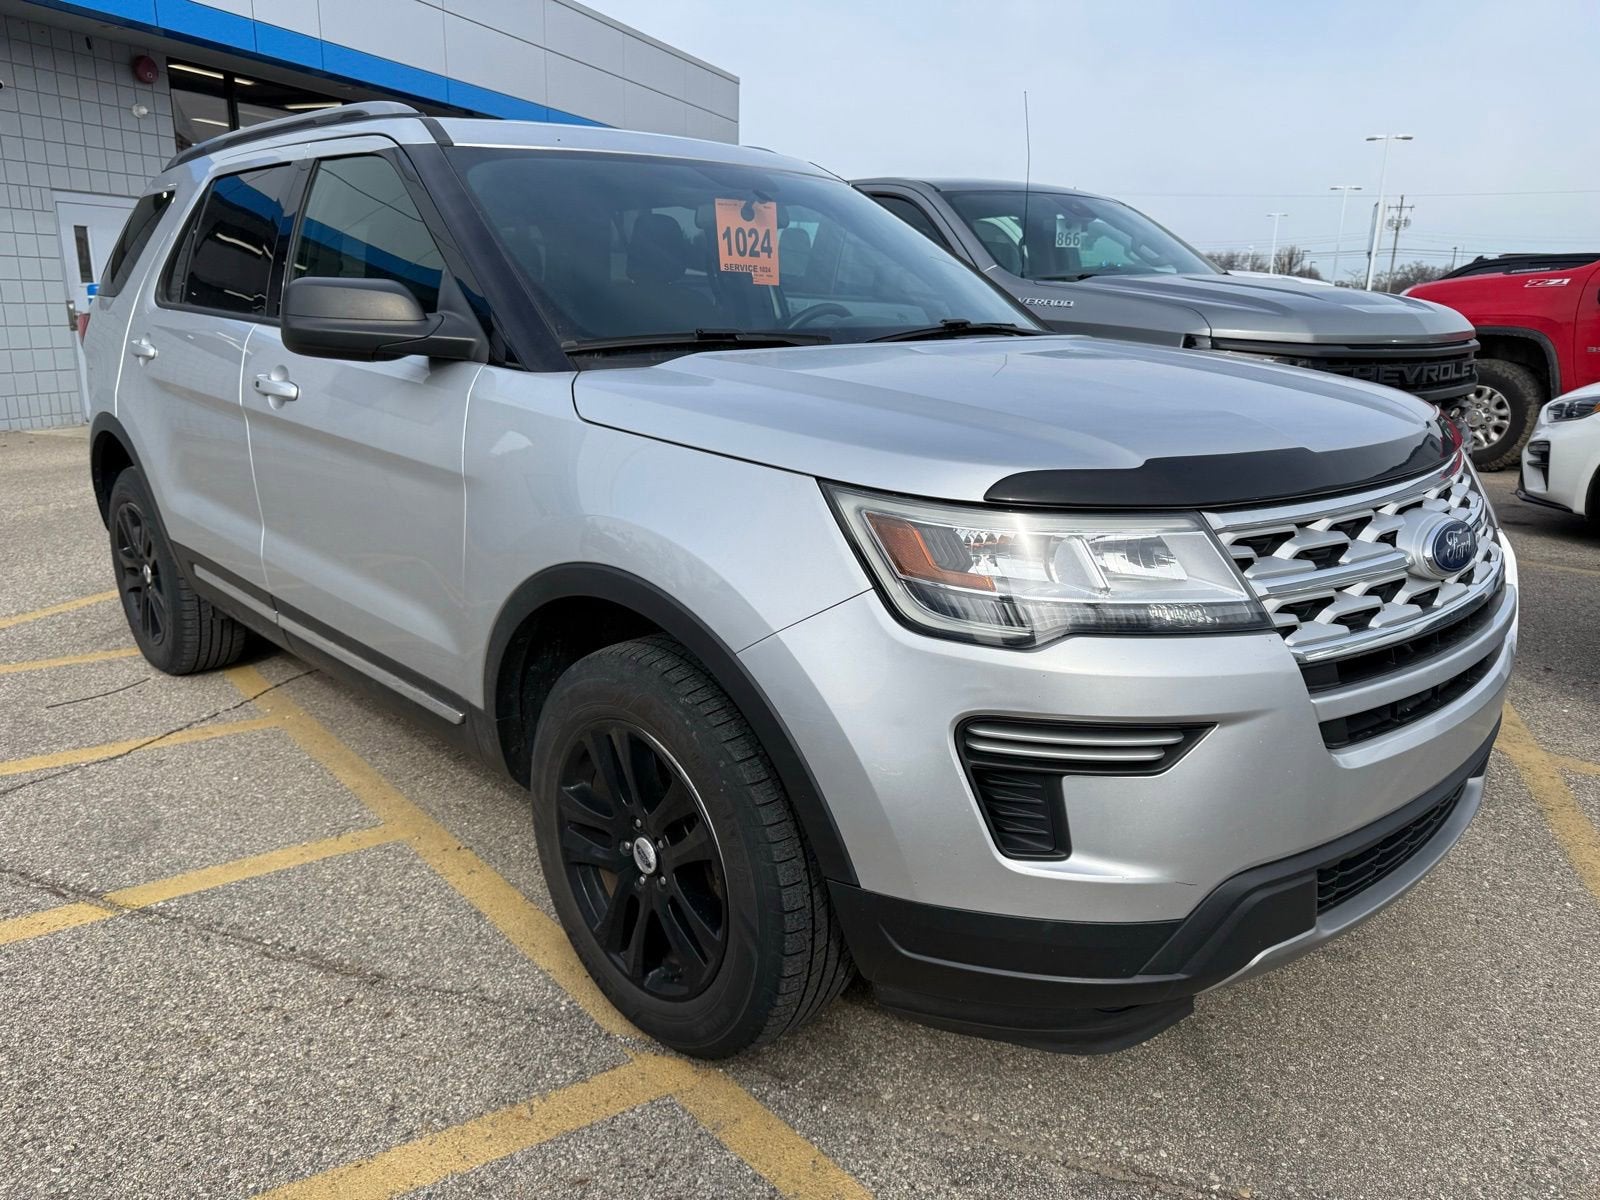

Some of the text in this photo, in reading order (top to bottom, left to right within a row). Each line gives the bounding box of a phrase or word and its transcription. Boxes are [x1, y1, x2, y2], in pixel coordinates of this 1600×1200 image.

[722, 226, 773, 258] 1024
[1057, 232, 1080, 246] 866
[724, 264, 758, 272] SERVICE
[1446, 528, 1471, 560] Ford
